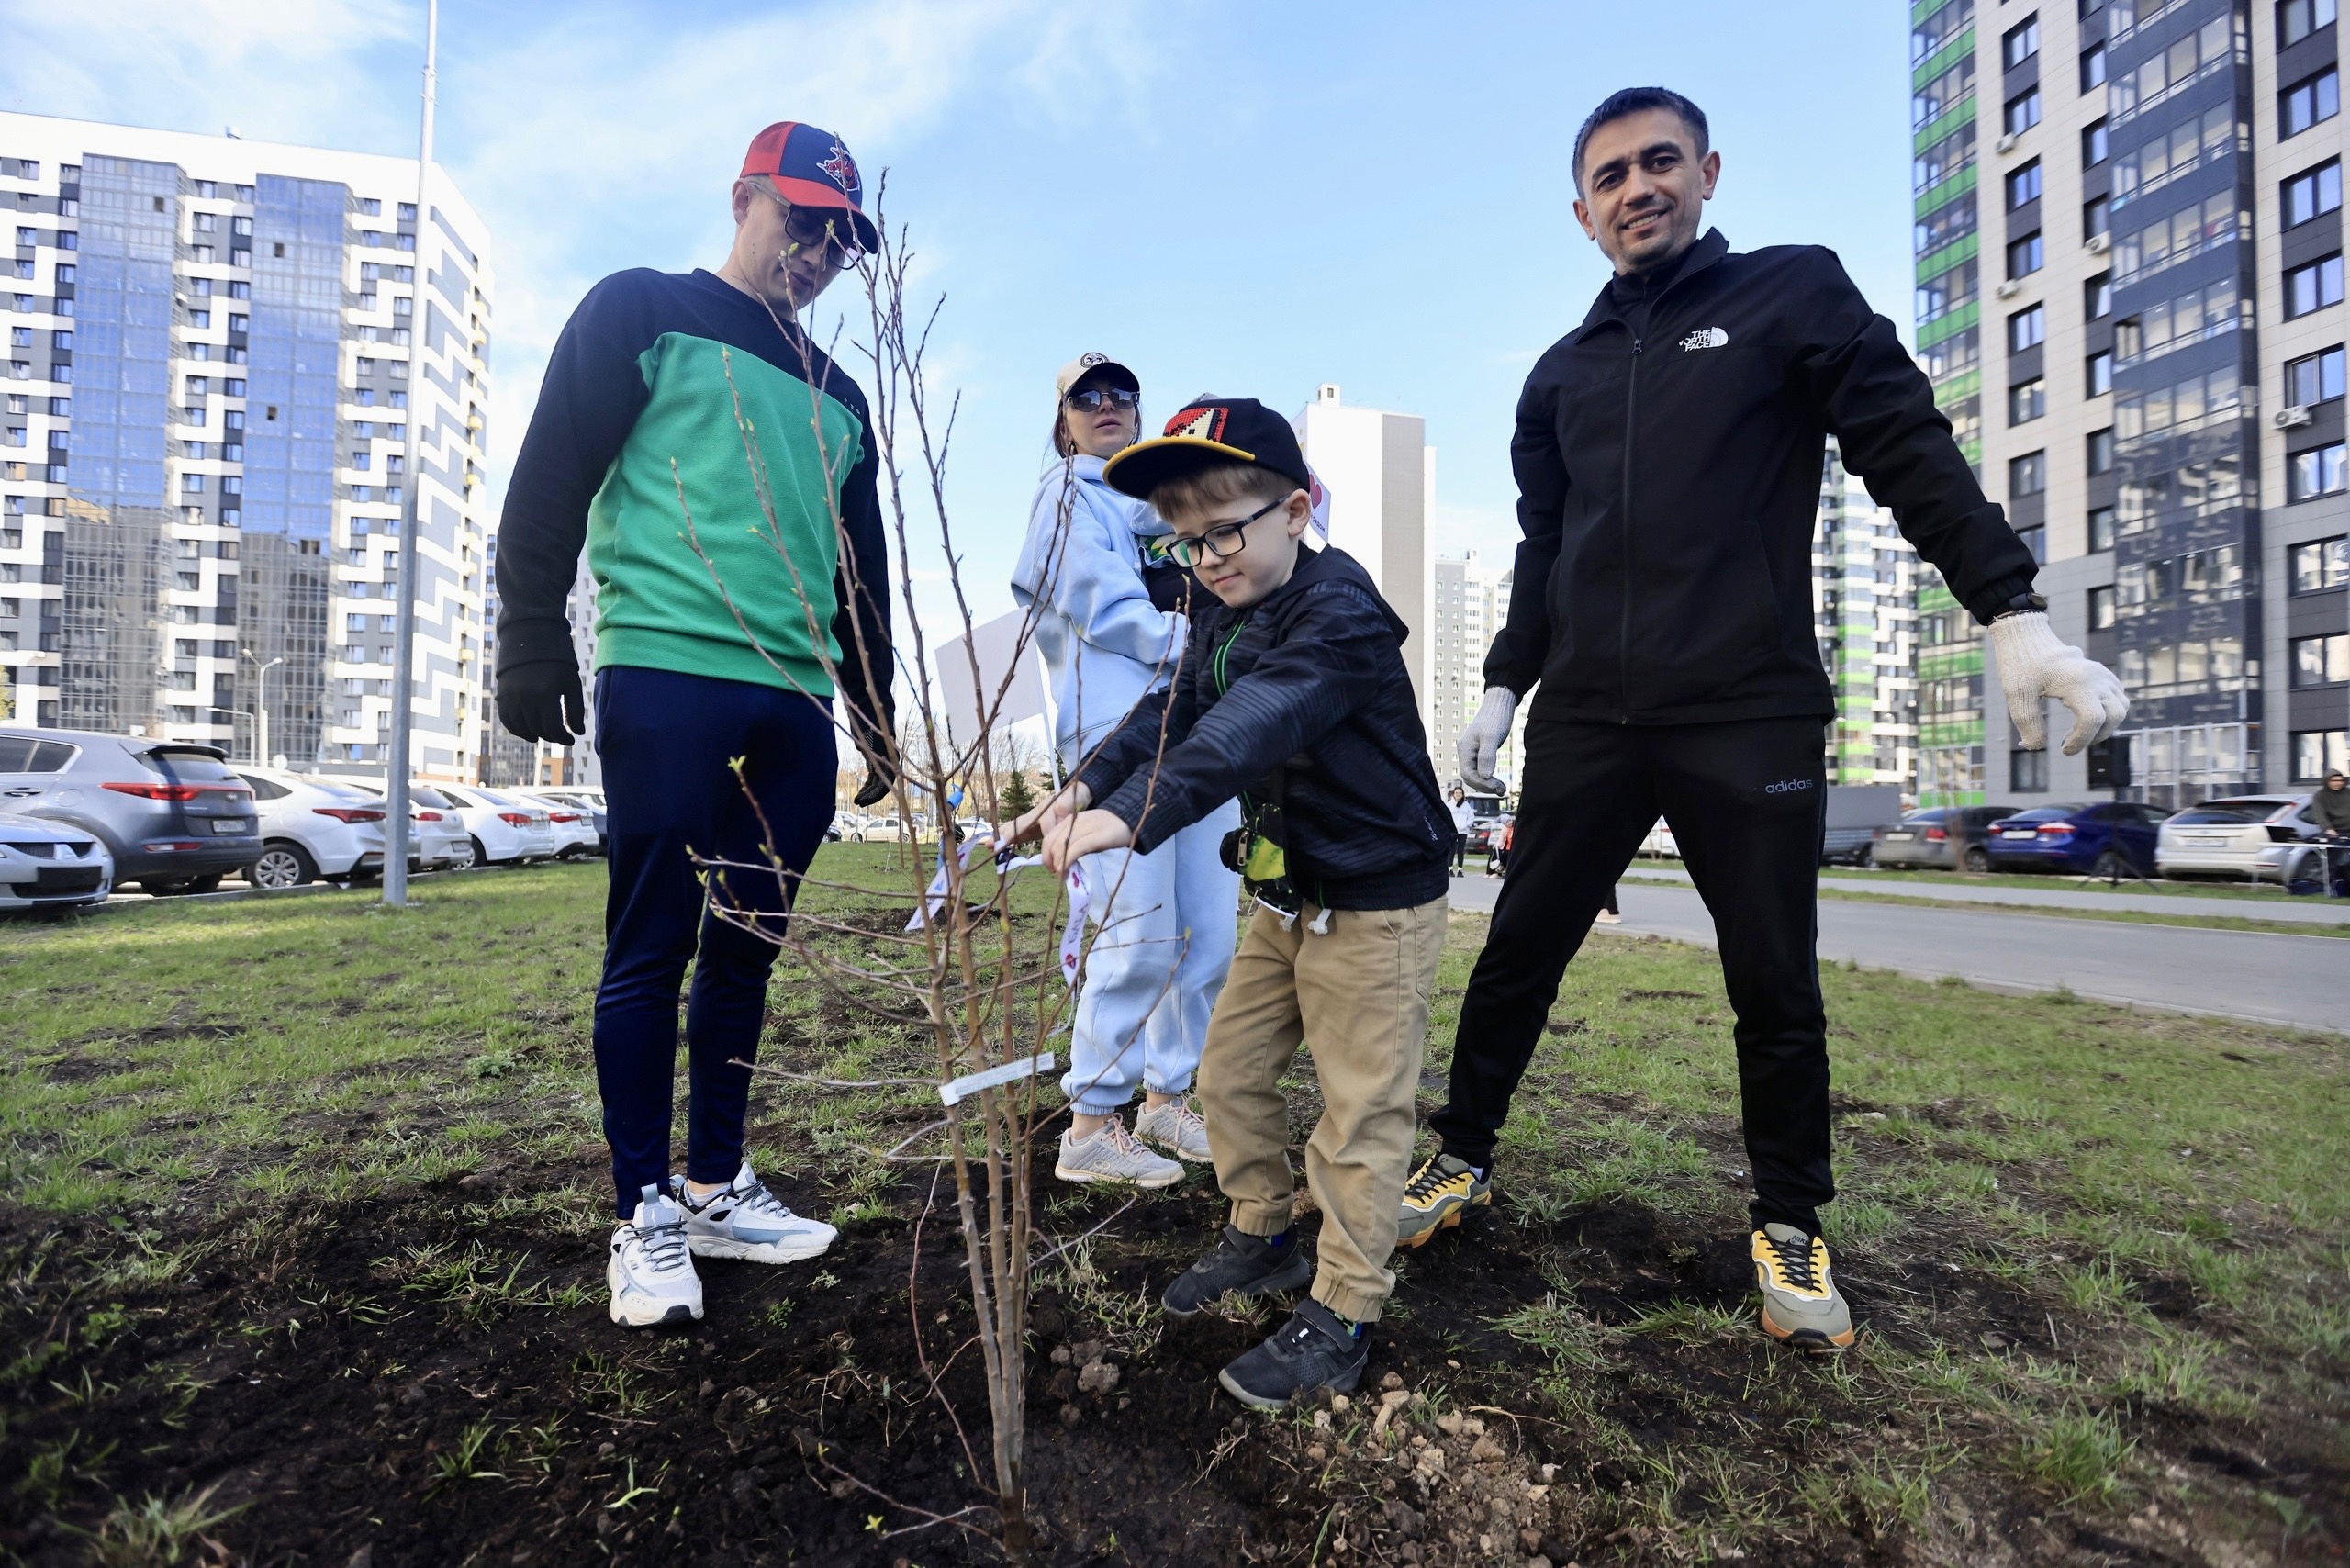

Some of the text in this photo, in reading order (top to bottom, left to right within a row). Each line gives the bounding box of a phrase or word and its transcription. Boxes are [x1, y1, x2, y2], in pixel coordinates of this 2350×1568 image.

[1691, 329, 1711, 338] THE
[1684, 341, 1710, 352] FACE
[1765, 778, 1813, 793] adidas
